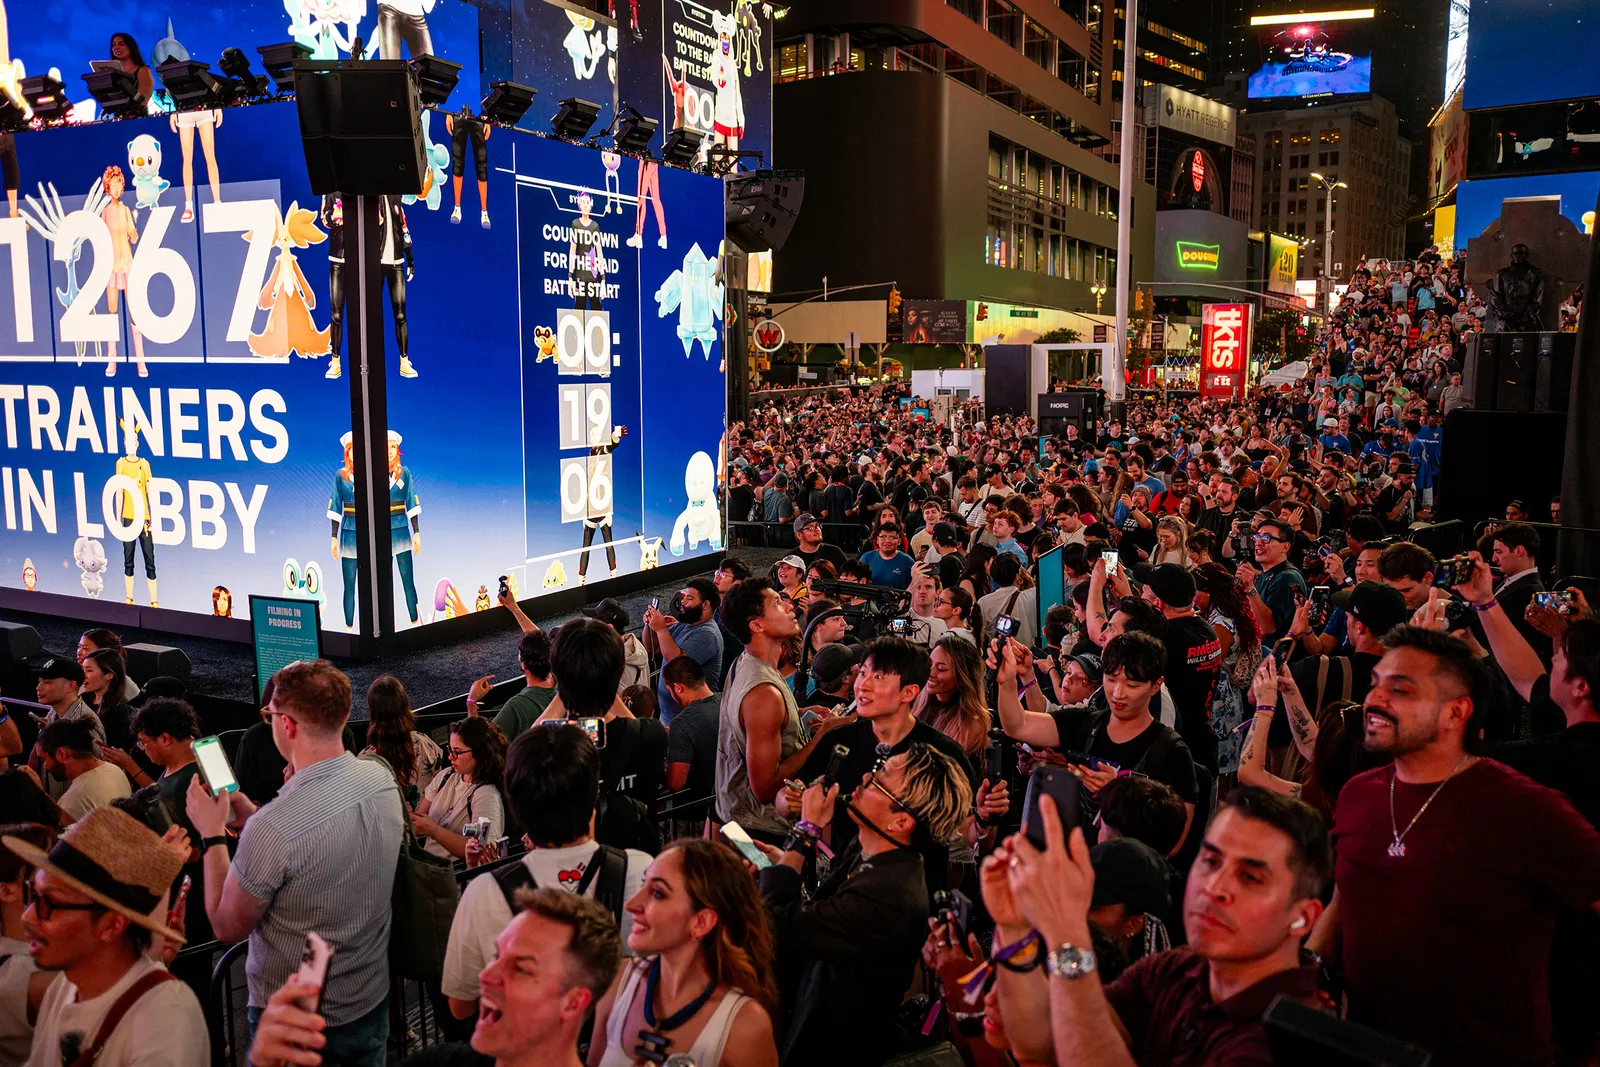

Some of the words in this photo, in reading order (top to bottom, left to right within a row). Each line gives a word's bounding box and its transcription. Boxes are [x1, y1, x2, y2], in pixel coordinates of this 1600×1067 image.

[673, 21, 719, 50] COUNTDOW
[676, 39, 687, 55] TO
[688, 44, 702, 62] THE
[703, 51, 714, 65] RA
[673, 56, 700, 78] BATTLE
[701, 67, 714, 82] STA
[684, 87, 715, 129] 00
[1176, 104, 1200, 122] HYATT
[1201, 112, 1231, 131] REGENCY
[542, 224, 619, 249] COUNTDOWN
[0, 199, 279, 344] 1267
[544, 251, 567, 269] FOR
[571, 254, 591, 271] THE
[594, 257, 619, 274] RAID
[1279, 251, 1294, 273] 120
[544, 278, 585, 297] BATTLE
[587, 281, 620, 299] START
[757, 329, 781, 346] W
[1212, 308, 1242, 368] tkts
[0, 384, 290, 464] TRAINERS
[563, 388, 611, 441] 19
[561, 460, 612, 515] 06
[2, 467, 57, 534] IN
[73, 472, 269, 554] LOBBY
[267, 605, 293, 617] FILMING
[293, 608, 301, 617] IN
[268, 617, 302, 629] PROGRESS
[616, 774, 637, 791] IT
